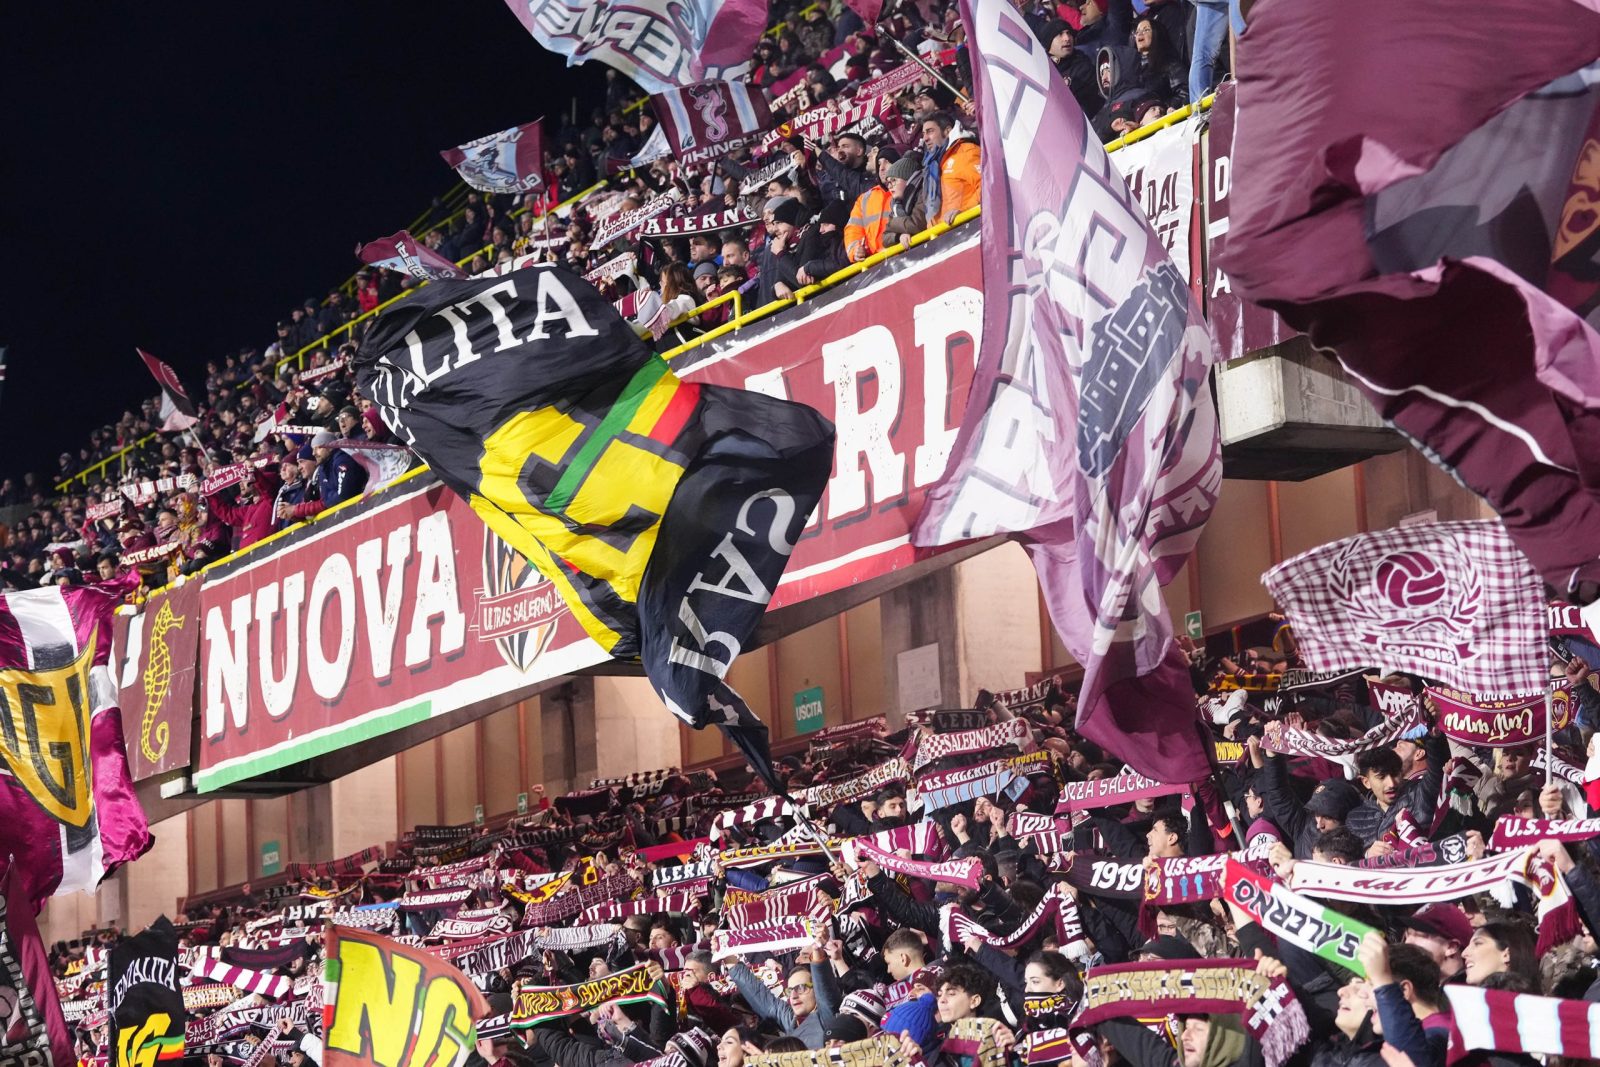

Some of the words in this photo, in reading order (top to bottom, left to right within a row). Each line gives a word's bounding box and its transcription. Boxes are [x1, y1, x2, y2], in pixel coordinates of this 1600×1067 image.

[206, 510, 466, 739] NUOVA
[484, 605, 512, 631] ULTRAS
[512, 591, 553, 622] SALERNO
[796, 701, 822, 721] USCITA
[1444, 708, 1533, 742] Cent'anni
[944, 727, 992, 752] SALERNO
[632, 779, 664, 799] 1919
[1090, 861, 1144, 892] 1919
[1164, 858, 1185, 877] U.S.
[1353, 877, 1408, 891] dal
[1425, 854, 1520, 890] 1919
[1233, 879, 1360, 959] SALERNO
